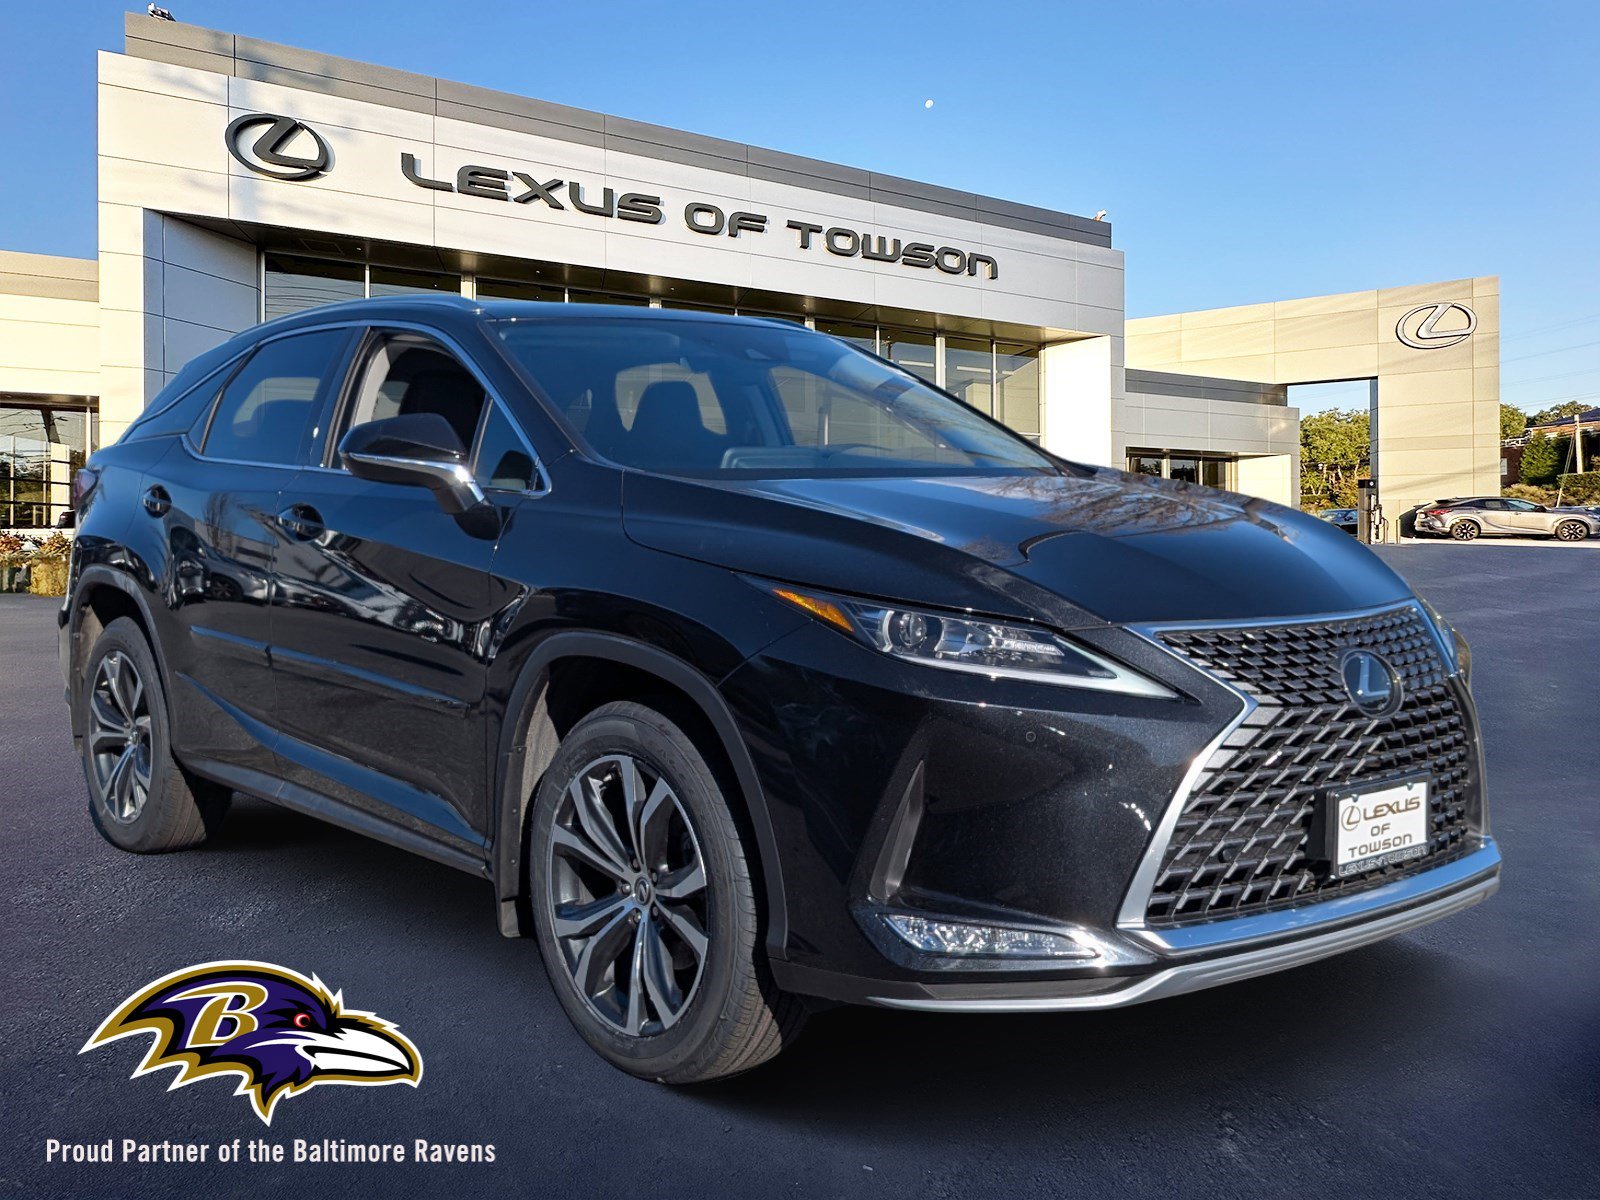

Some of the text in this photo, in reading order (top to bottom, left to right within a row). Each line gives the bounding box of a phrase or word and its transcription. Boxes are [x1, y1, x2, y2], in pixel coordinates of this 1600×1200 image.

[401, 152, 999, 280] LEXUS OF TOWSON
[1363, 796, 1421, 821] LEXUS
[1370, 822, 1391, 837] OF
[1348, 833, 1413, 858] TOWSON
